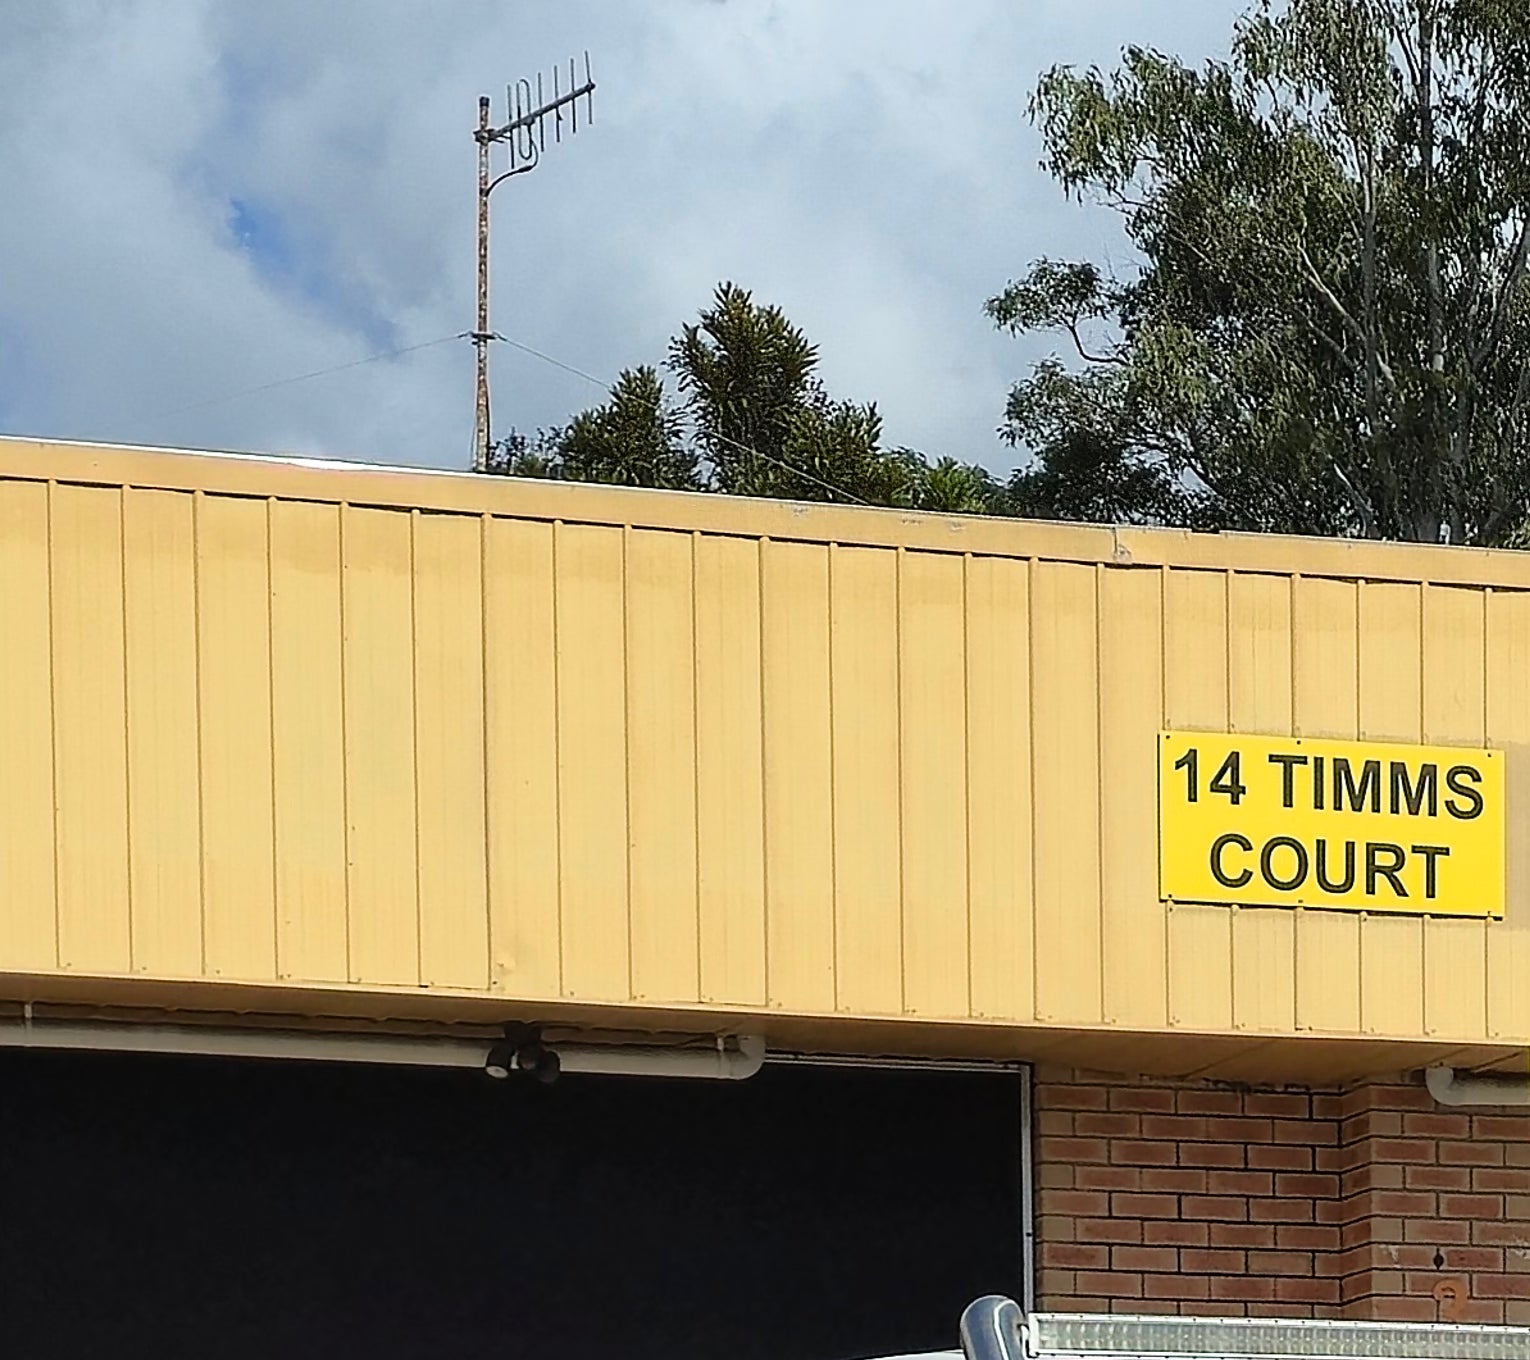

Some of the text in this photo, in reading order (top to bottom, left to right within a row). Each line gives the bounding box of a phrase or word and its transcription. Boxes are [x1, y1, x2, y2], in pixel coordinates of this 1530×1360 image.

[1173, 747, 1485, 821] 14 TIMMS
[1209, 832, 1451, 899] COURT
